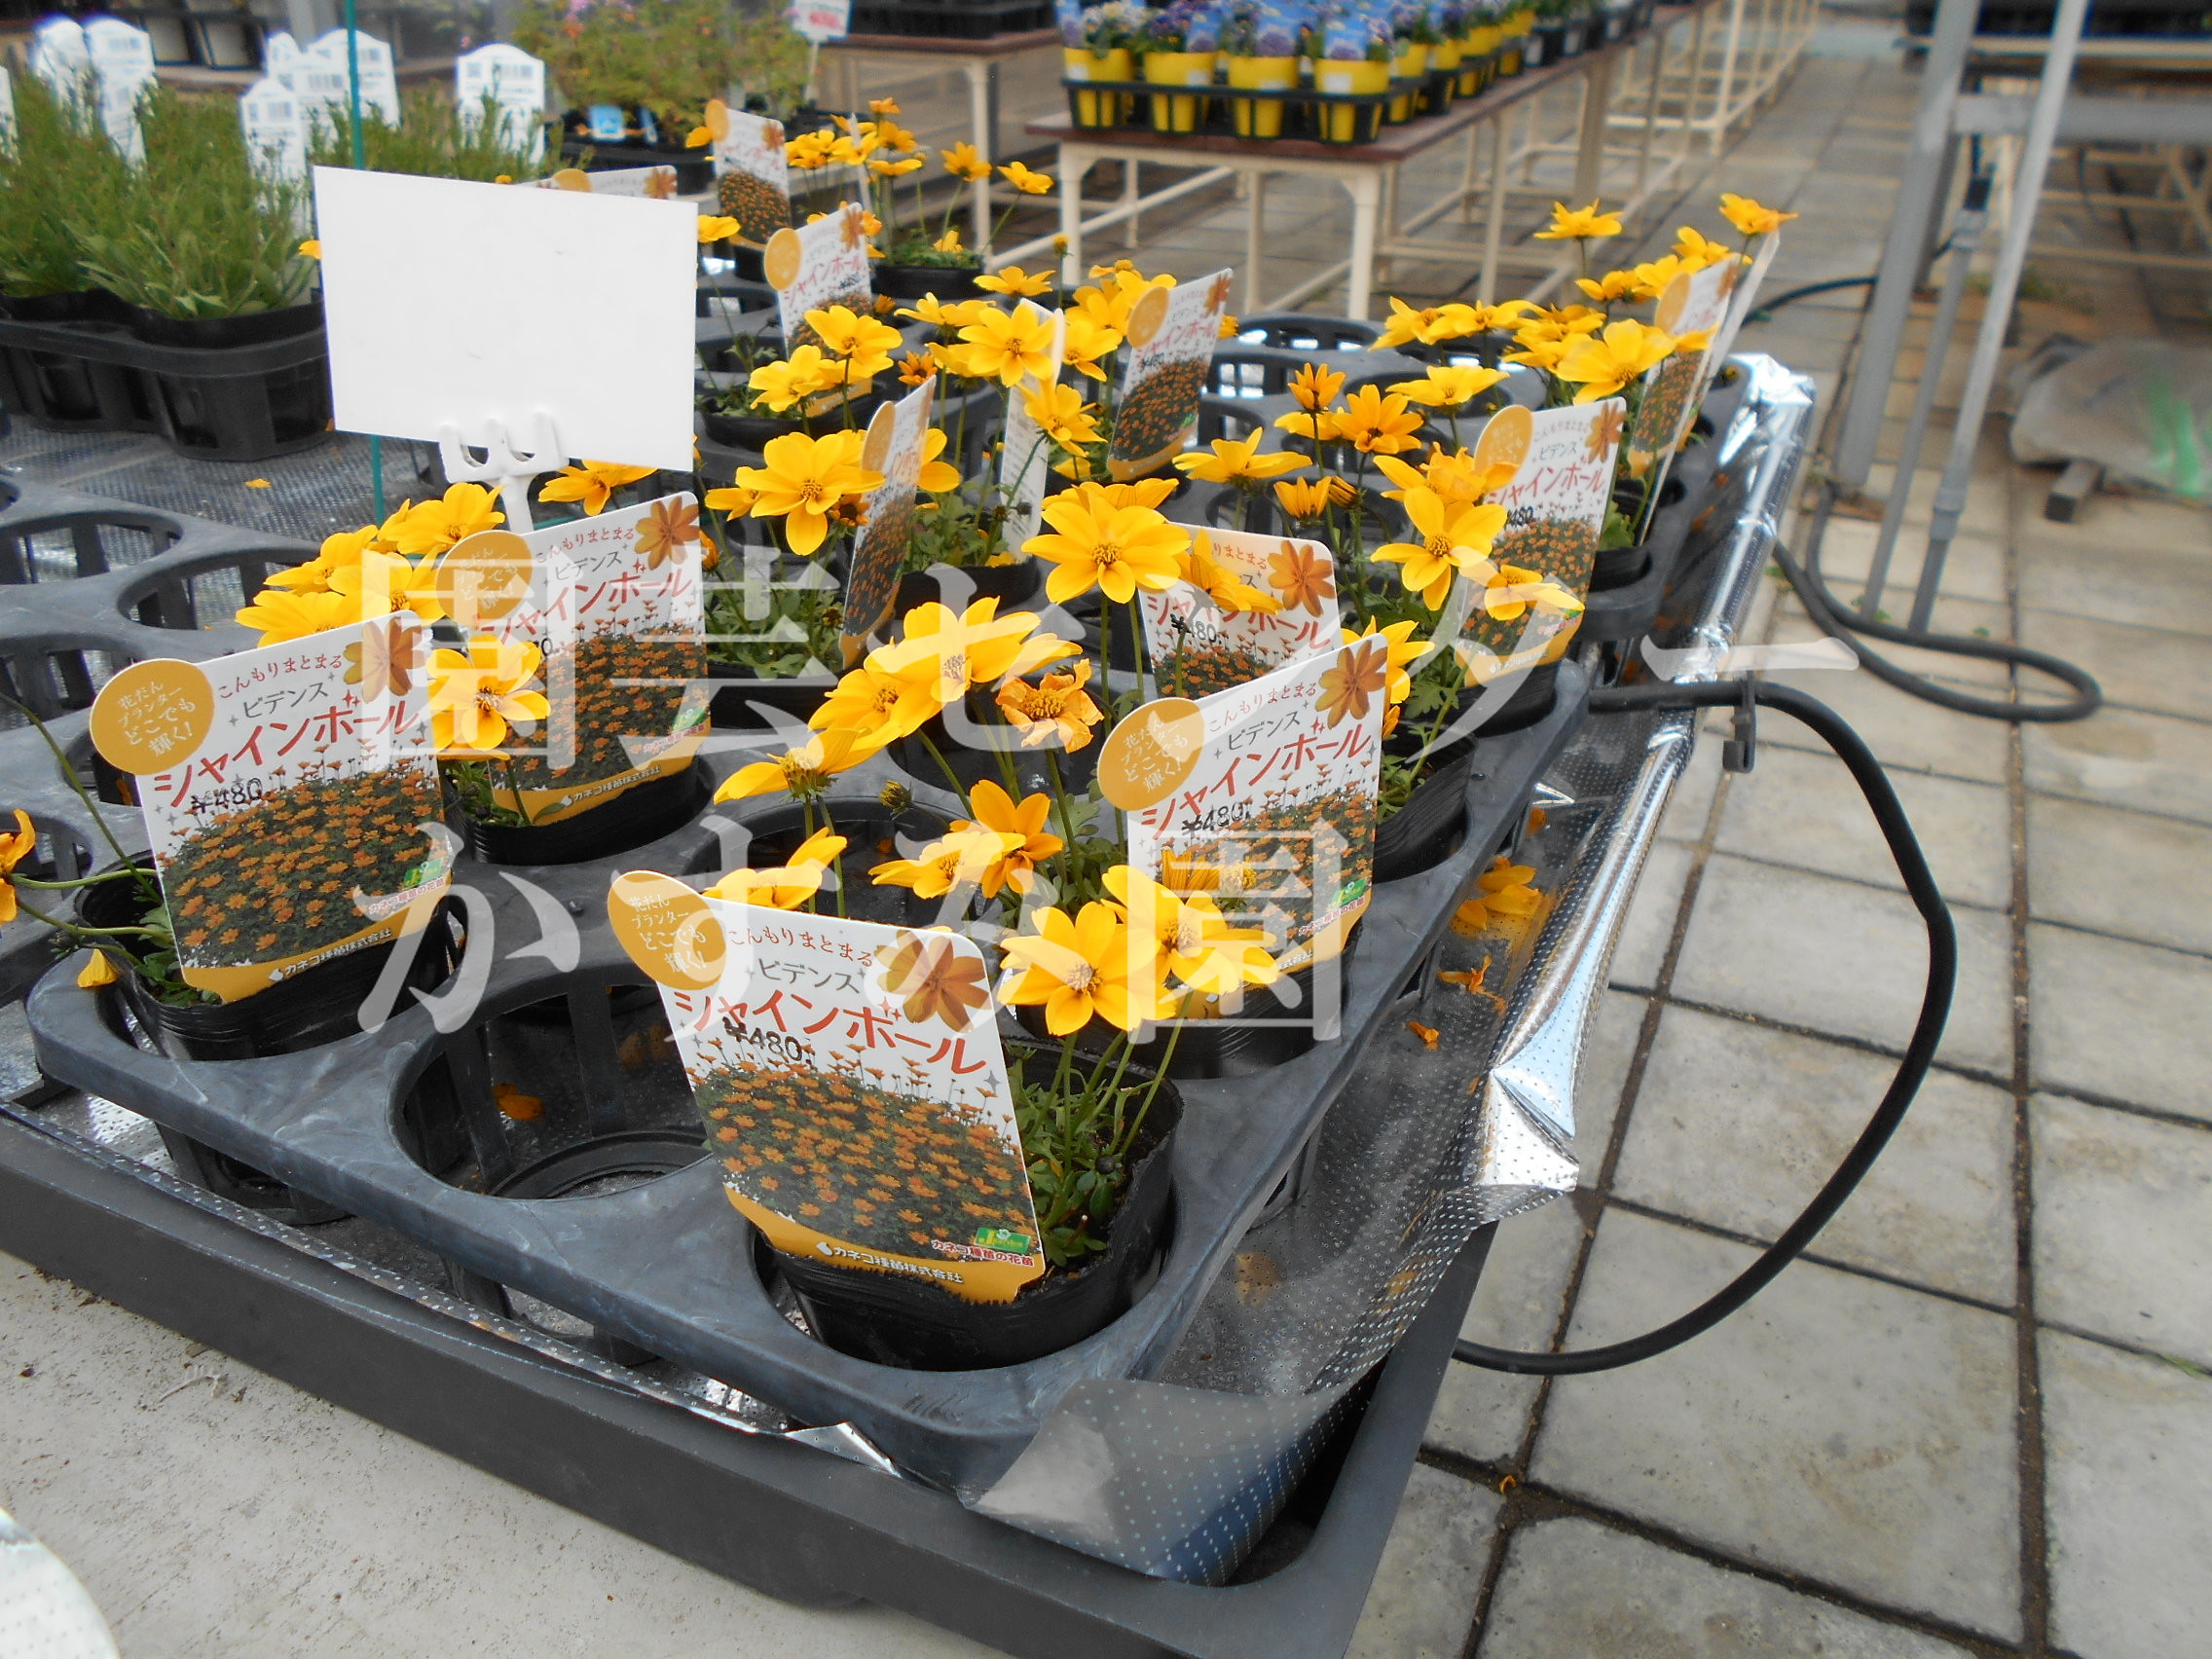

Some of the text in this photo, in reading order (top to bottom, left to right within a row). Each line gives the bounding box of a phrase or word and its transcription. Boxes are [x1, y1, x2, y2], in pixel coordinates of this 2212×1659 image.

[1539, 441, 1578, 461] ビデンス
[535, 527, 635, 564] こんもりまとまる
[1213, 541, 1267, 570] りまとまる
[555, 550, 623, 581] ビデンス
[118, 681, 164, 709] 花だん
[217, 653, 344, 699] こんもりまとまる
[243, 682, 329, 719] ビデンス
[1209, 682, 1317, 733] こんもりまとまる
[125, 698, 196, 745] どこでも
[148, 721, 193, 756] 輝く!
[1124, 719, 1164, 748] 花だん
[1228, 711, 1301, 751] ビデンス
[154, 697, 420, 807] シャインボール
[1124, 734, 1188, 783] どこでも
[1141, 723, 1372, 840] シャインボール
[368, 877, 446, 915] カネコ種苗の花苗
[628, 894, 670, 911] 花だん
[284, 928, 392, 977] カネコ種苗株式会社
[639, 924, 707, 951] どこでも
[727, 925, 874, 967] こんもりまとまる
[664, 949, 707, 974] 輝く!
[758, 957, 861, 995] ビデンス
[673, 986, 987, 1075] シャインボール
[833, 1246, 964, 1284] カネコ種苗株式会社
[931, 1238, 1034, 1267] カネコ種苗の花苗
